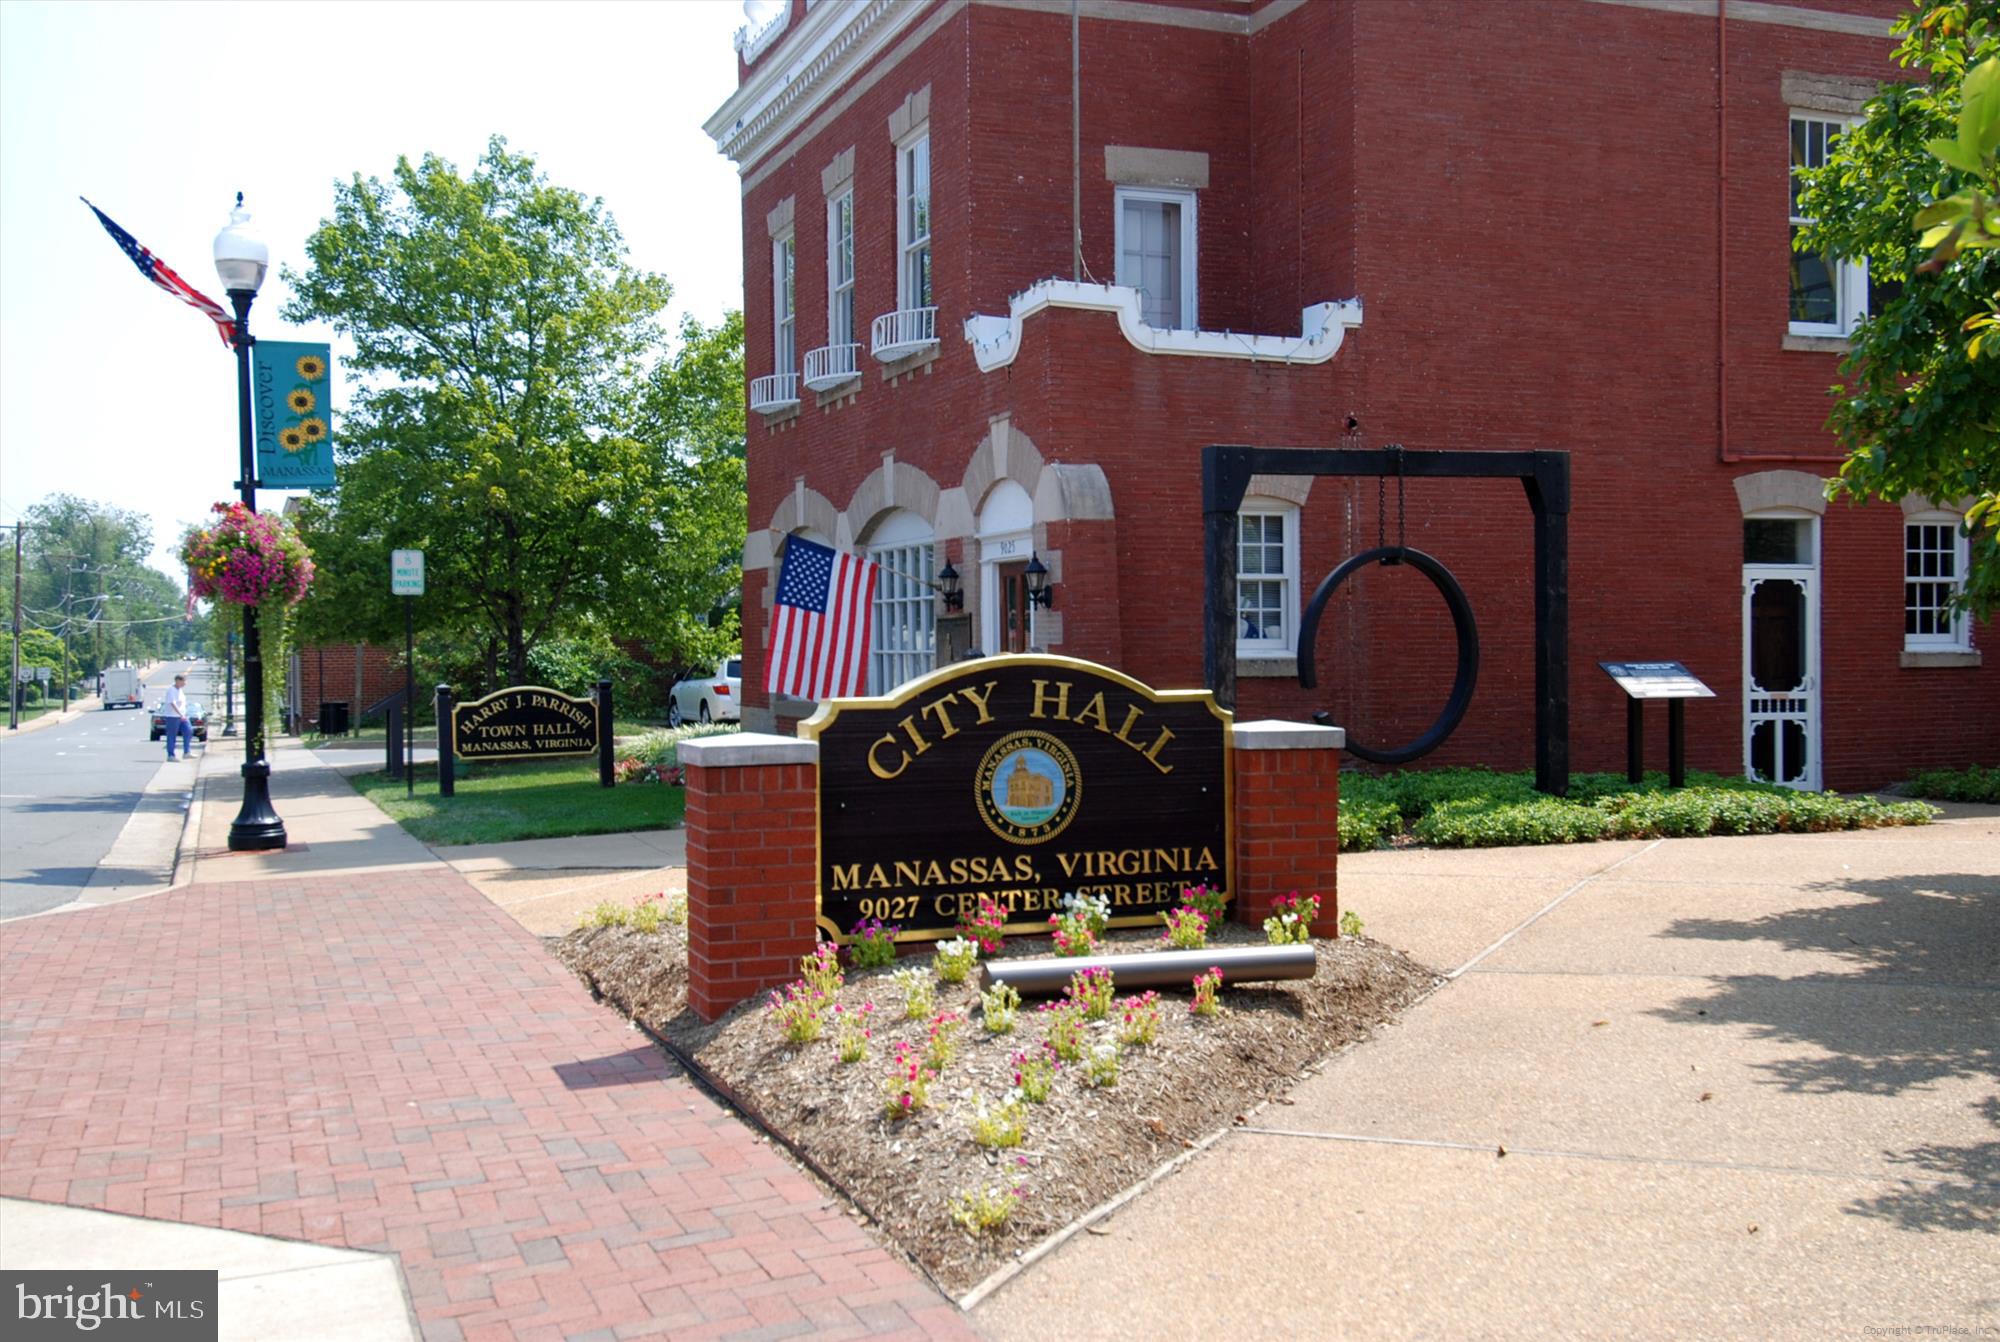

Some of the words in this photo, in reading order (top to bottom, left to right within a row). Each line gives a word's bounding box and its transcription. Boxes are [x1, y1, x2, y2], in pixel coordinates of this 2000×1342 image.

[262, 464, 331, 477] MANASSAS
[394, 580, 422, 588] PARKING
[460, 697, 509, 734] HARRY
[515, 695, 526, 709] J.
[531, 694, 593, 730] PARRISH
[478, 724, 526, 738] TOWN
[533, 722, 576, 736] HALL
[867, 680, 998, 780] CITY
[1029, 679, 1176, 774] HALL
[462, 740, 532, 753] MANASSAS,
[536, 737, 592, 749] VIRGINIA
[1036, 739, 1075, 788] VIRGINIA
[1008, 823, 1051, 838] 1873
[831, 854, 1042, 891] MANASSAS,
[1056, 846, 1219, 878] VIRGINIA
[858, 896, 920, 921] 9027
[934, 889, 1063, 917] CENTER
